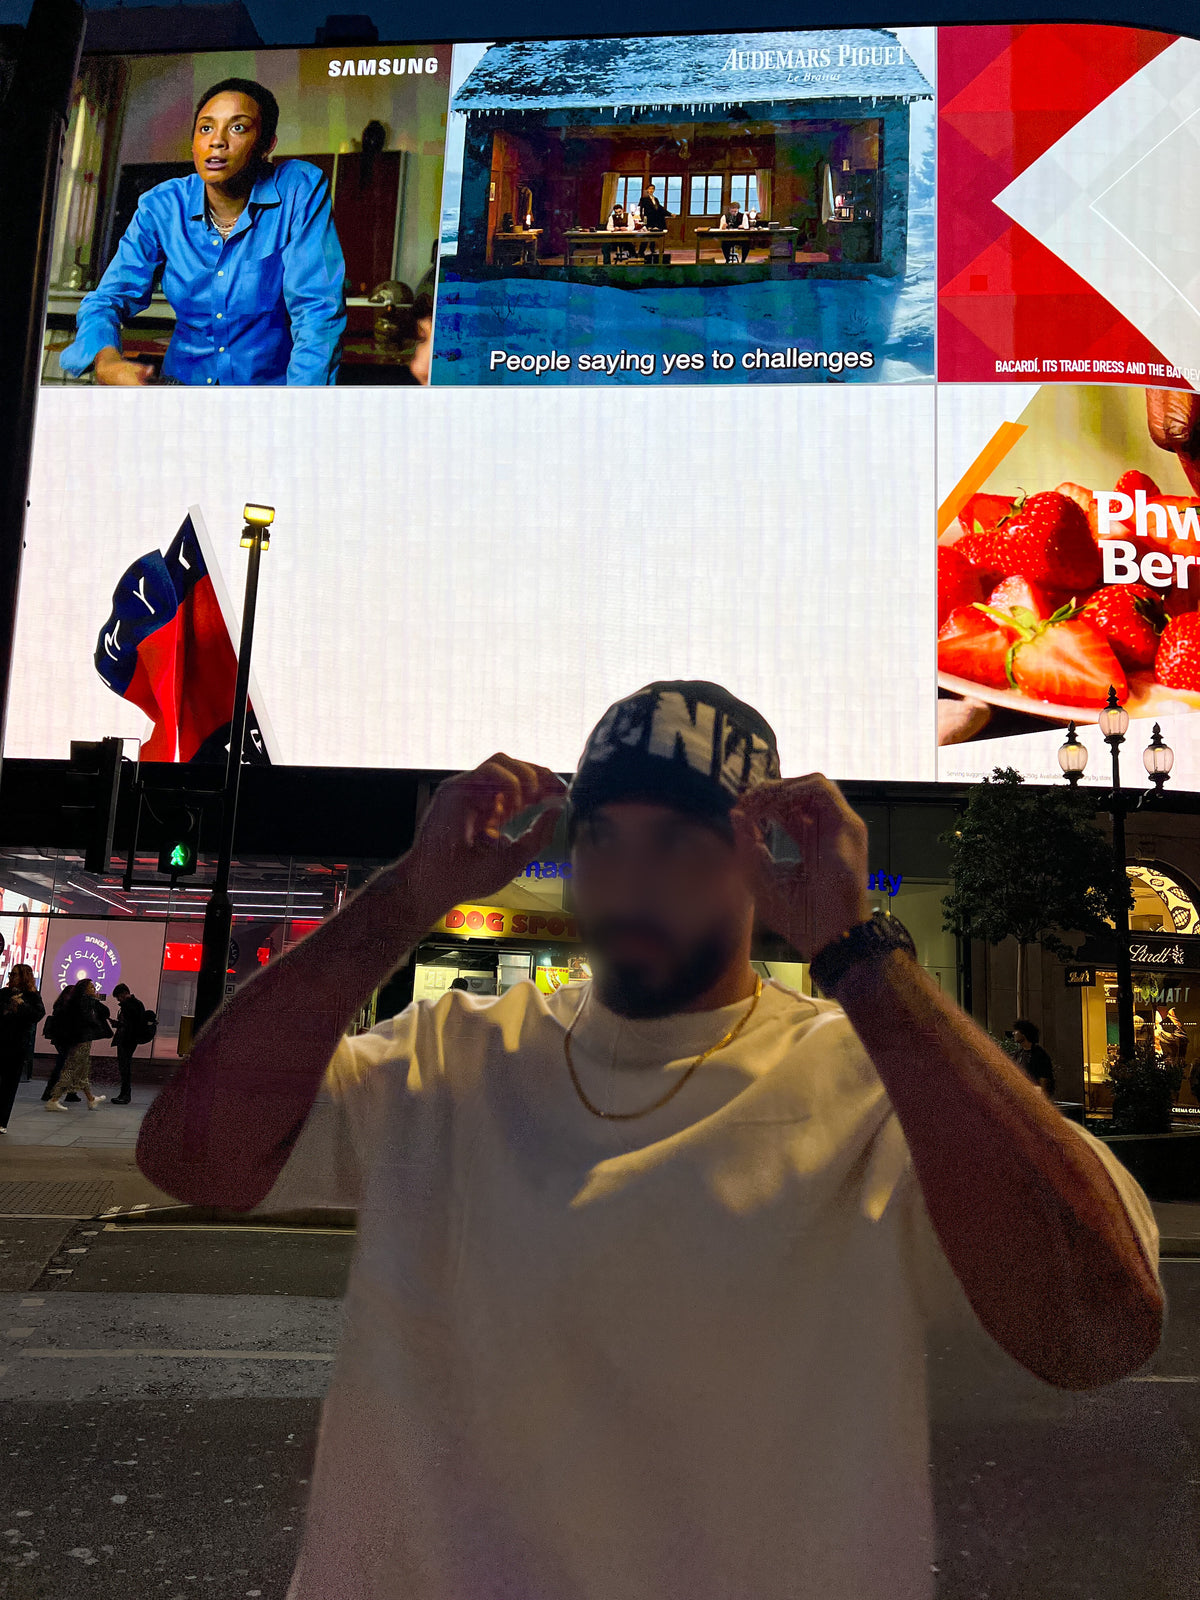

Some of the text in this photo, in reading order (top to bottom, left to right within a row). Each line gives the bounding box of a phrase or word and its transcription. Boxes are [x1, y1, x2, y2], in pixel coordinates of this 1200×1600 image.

[328, 57, 438, 77] SAMSUNG
[721, 44, 907, 71] AUDEMARS PIGUET
[490, 348, 874, 375] People saying yes to challenges
[1042, 359, 1058, 373] ITS
[1059, 359, 1091, 373] TRADE
[1093, 360, 1124, 374] DRESS
[1126, 362, 1146, 375] AND
[1147, 363, 1165, 377] THE
[1166, 365, 1183, 379] BAT
[1093, 489, 1200, 541] Phw
[1098, 540, 1200, 589] Ber
[445, 909, 504, 932] DOG
[85, 936, 117, 966] THE VENUE
[1129, 944, 1171, 963] Lindt
[74, 950, 105, 980] LIGHTS
